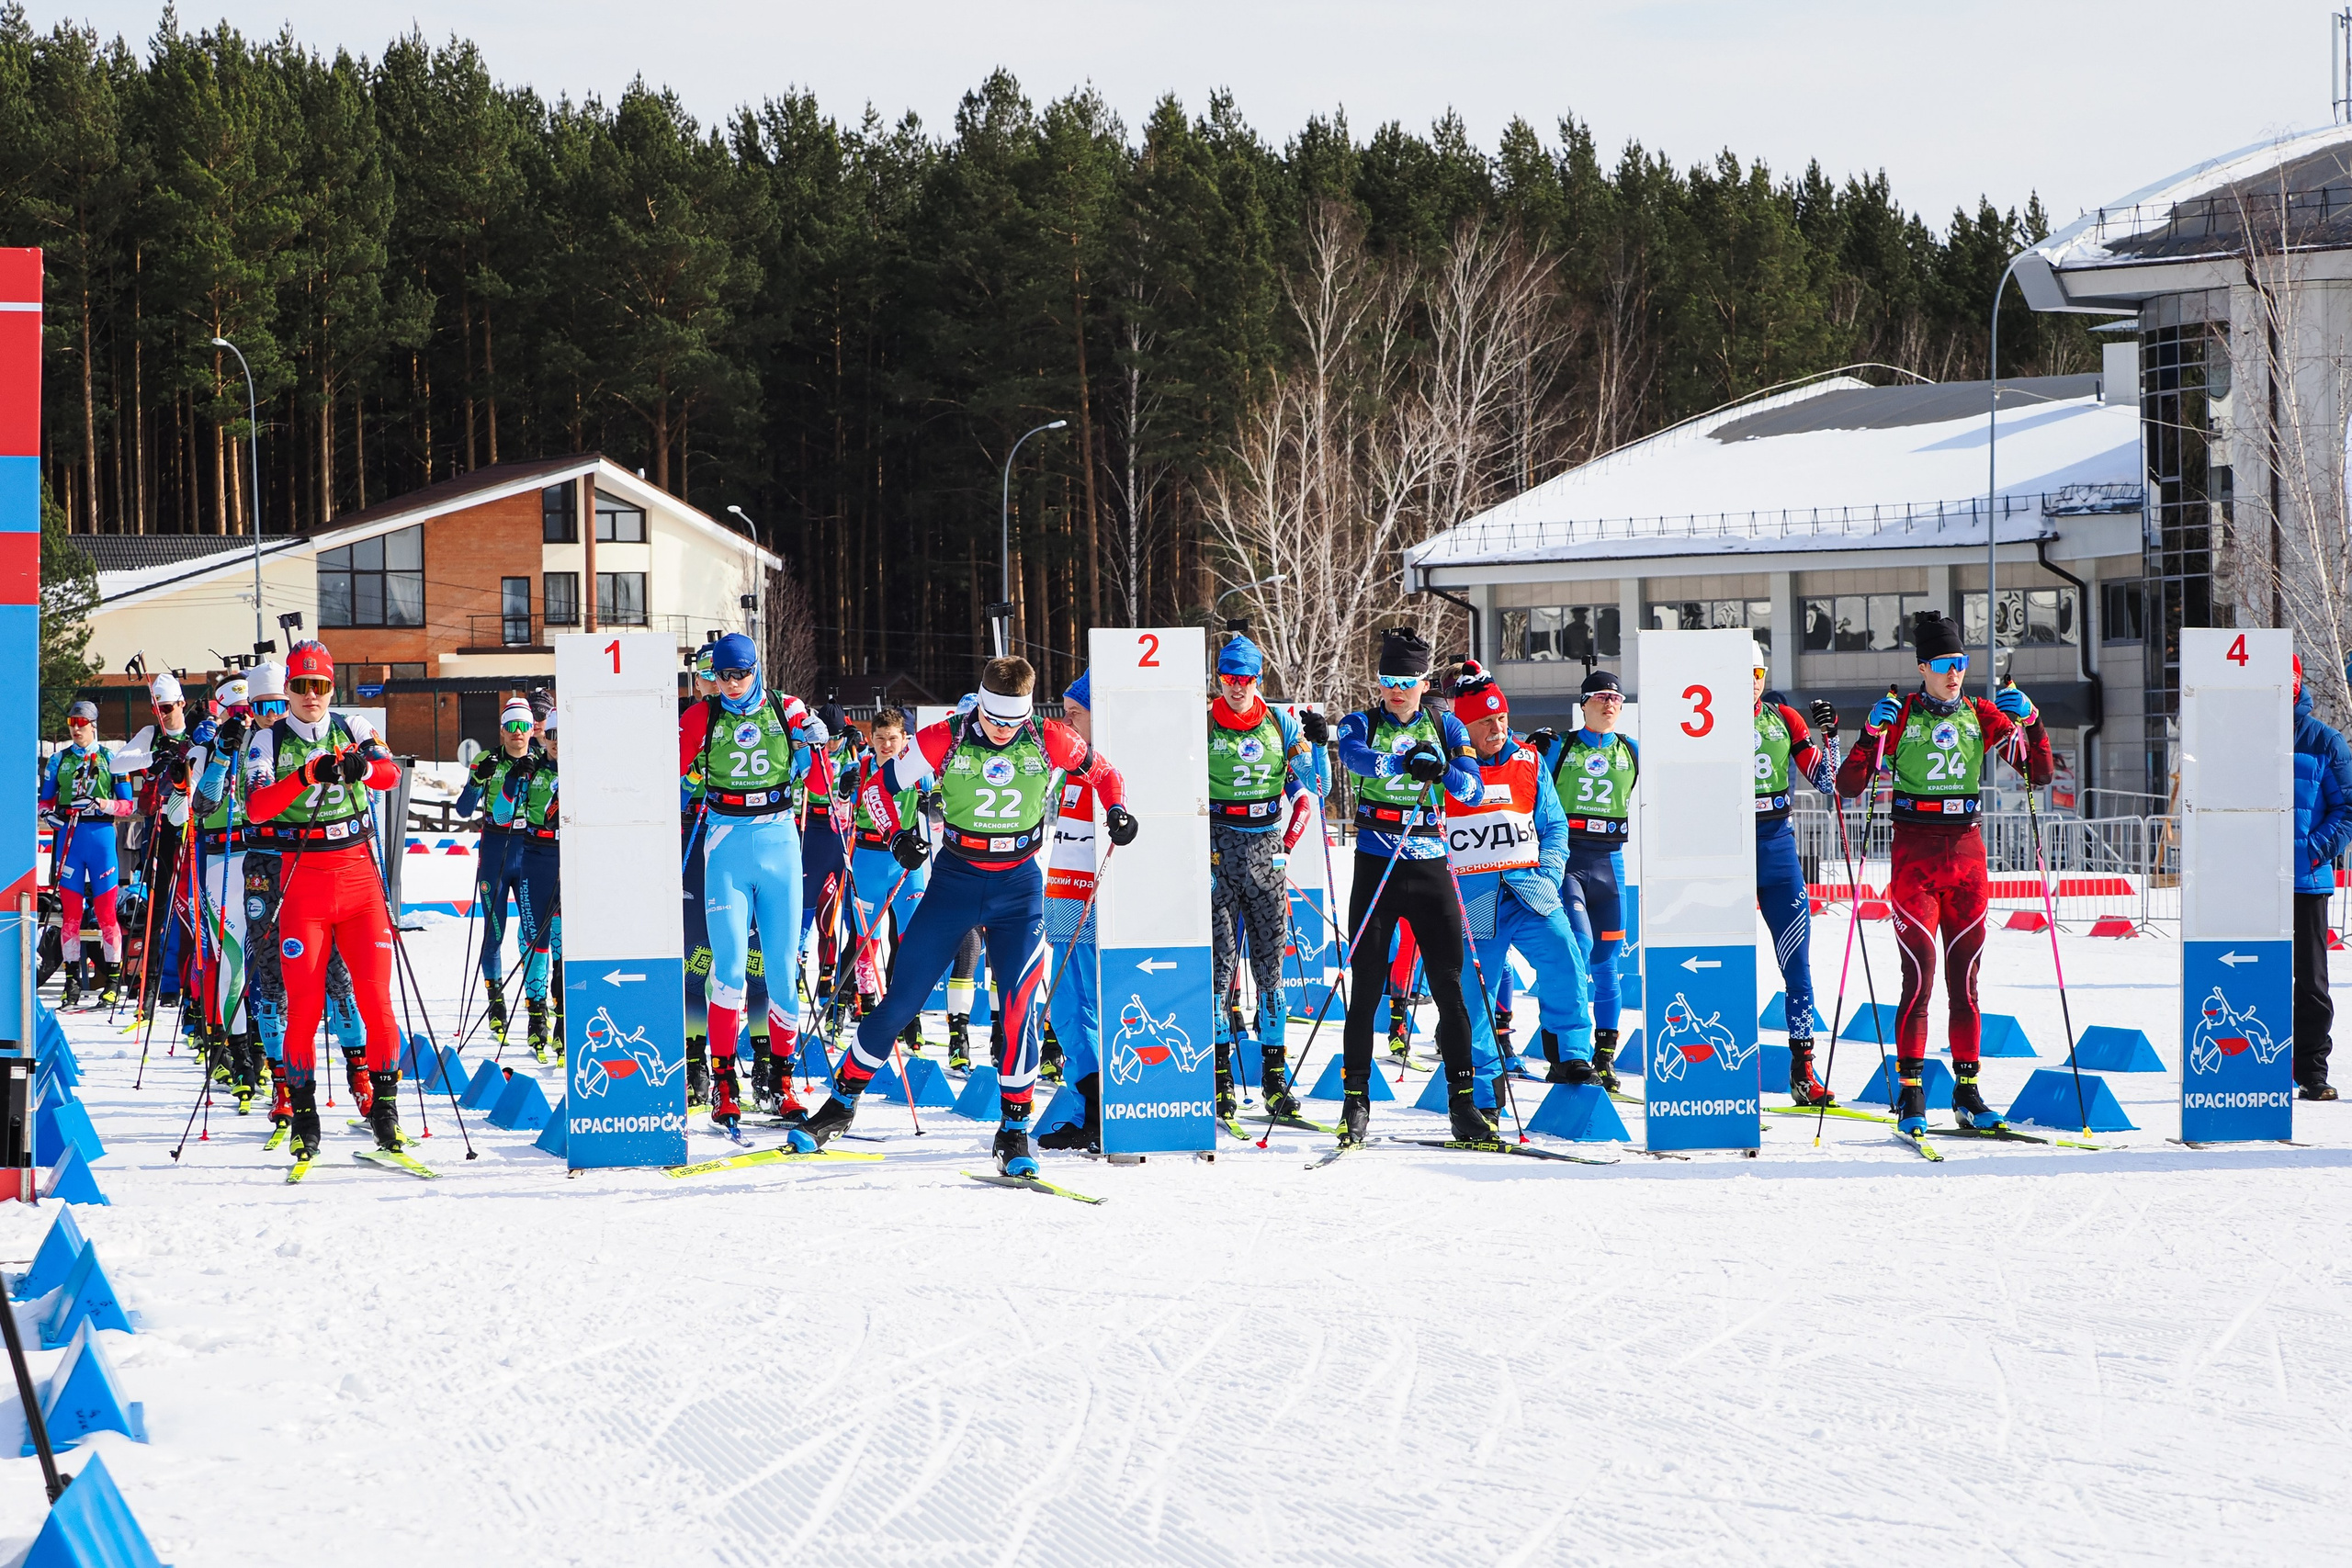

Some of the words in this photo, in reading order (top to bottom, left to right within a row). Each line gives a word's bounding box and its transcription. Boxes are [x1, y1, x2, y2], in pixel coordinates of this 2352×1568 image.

[605, 639, 620, 673] 1
[1138, 633, 1159, 667] 2
[2226, 634, 2248, 667] 4
[1680, 685, 1714, 737] 3
[729, 750, 770, 777] 26
[1518, 750, 1532, 761] 35
[1927, 752, 1966, 780] 24
[1233, 764, 1272, 786] 27
[305, 781, 345, 808] 25
[974, 788, 1023, 818] 22
[1577, 777, 1614, 804] 32
[1449, 819, 1538, 852] СУДЬЯ
[1073, 878, 1094, 889] кра
[210, 897, 236, 930] ЮГОИЯ
[1105, 1100, 1213, 1120] КРАСНОЯРСК
[1649, 1099, 1758, 1117] КРАСНОЯРСК
[2185, 1091, 2290, 1109] КРАСНОЯРСК
[570, 1114, 685, 1134] КРАСНОЯРСК
[1444, 1141, 1499, 1153] FISCHER
[679, 1159, 721, 1176] FISCHER
